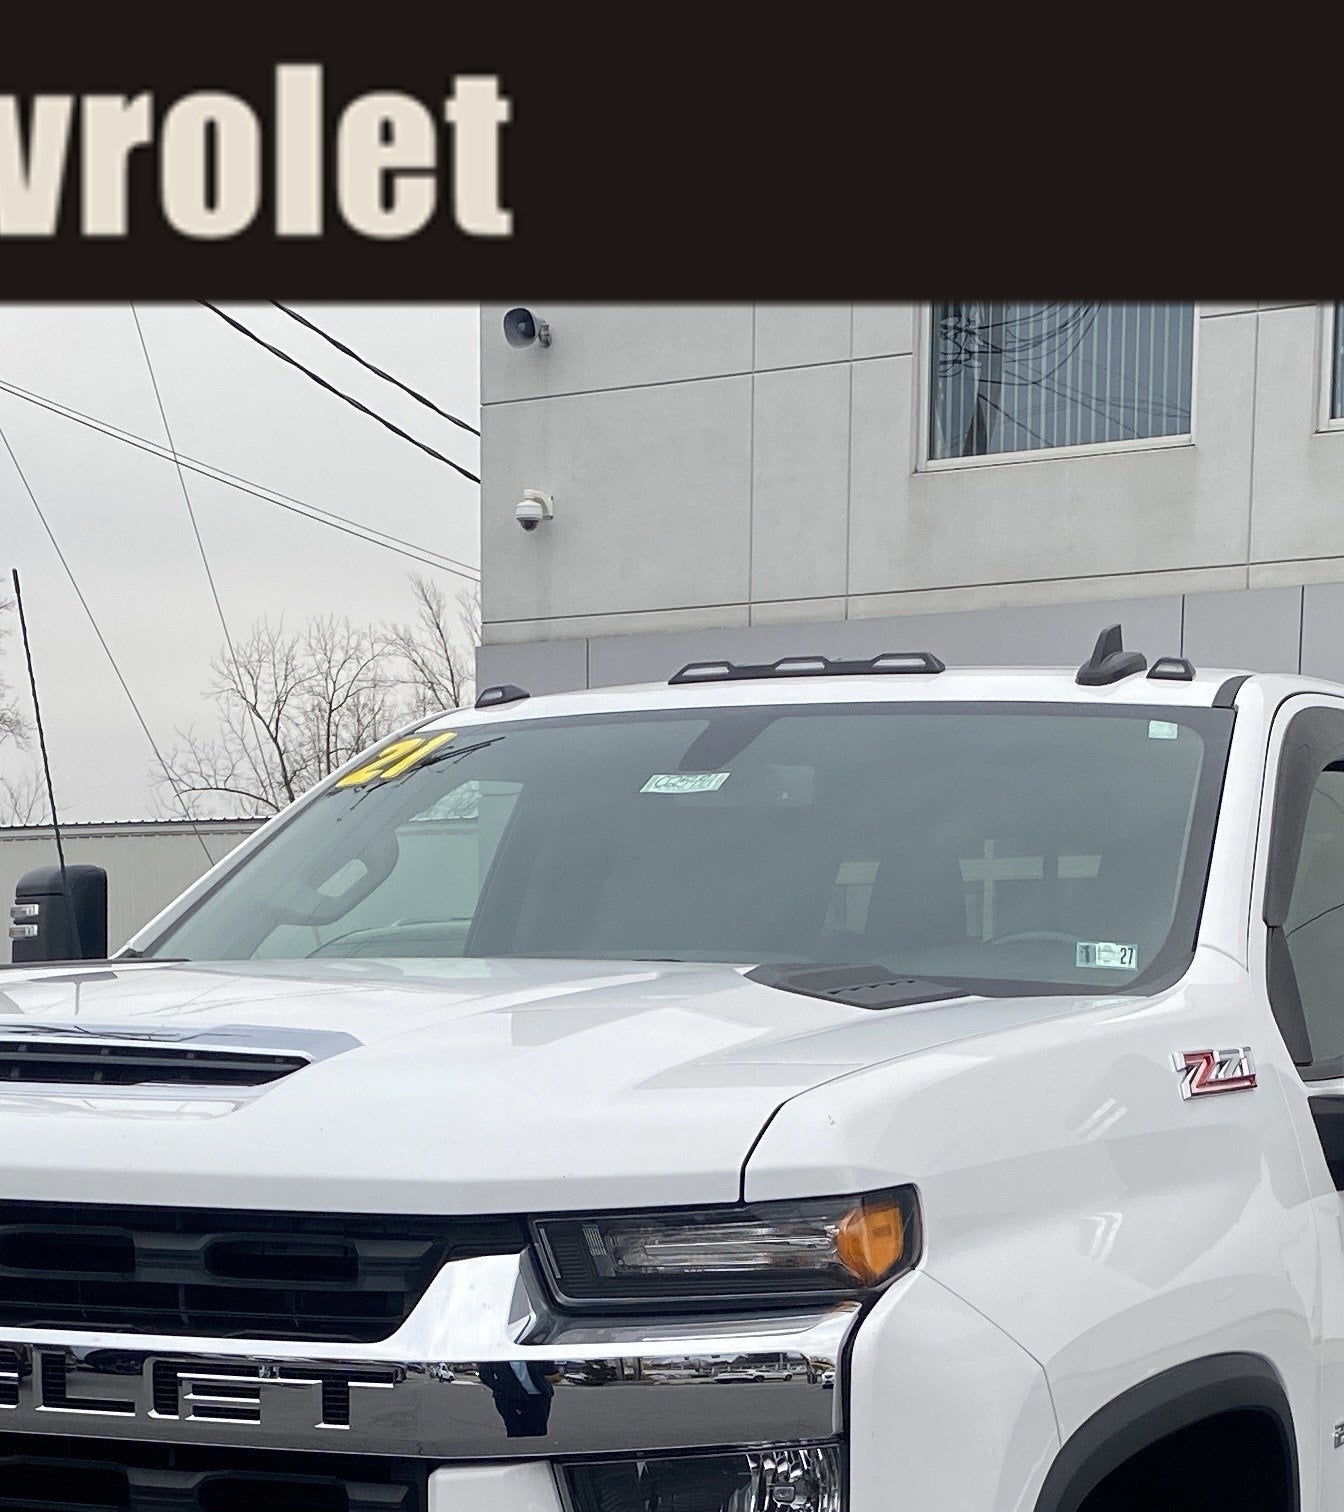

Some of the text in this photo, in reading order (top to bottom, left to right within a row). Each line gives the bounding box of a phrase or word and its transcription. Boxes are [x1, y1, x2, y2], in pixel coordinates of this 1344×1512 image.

[334, 730, 457, 788] 21
[1120, 947, 1134, 966] 27
[1171, 1046, 1257, 1101] Z71
